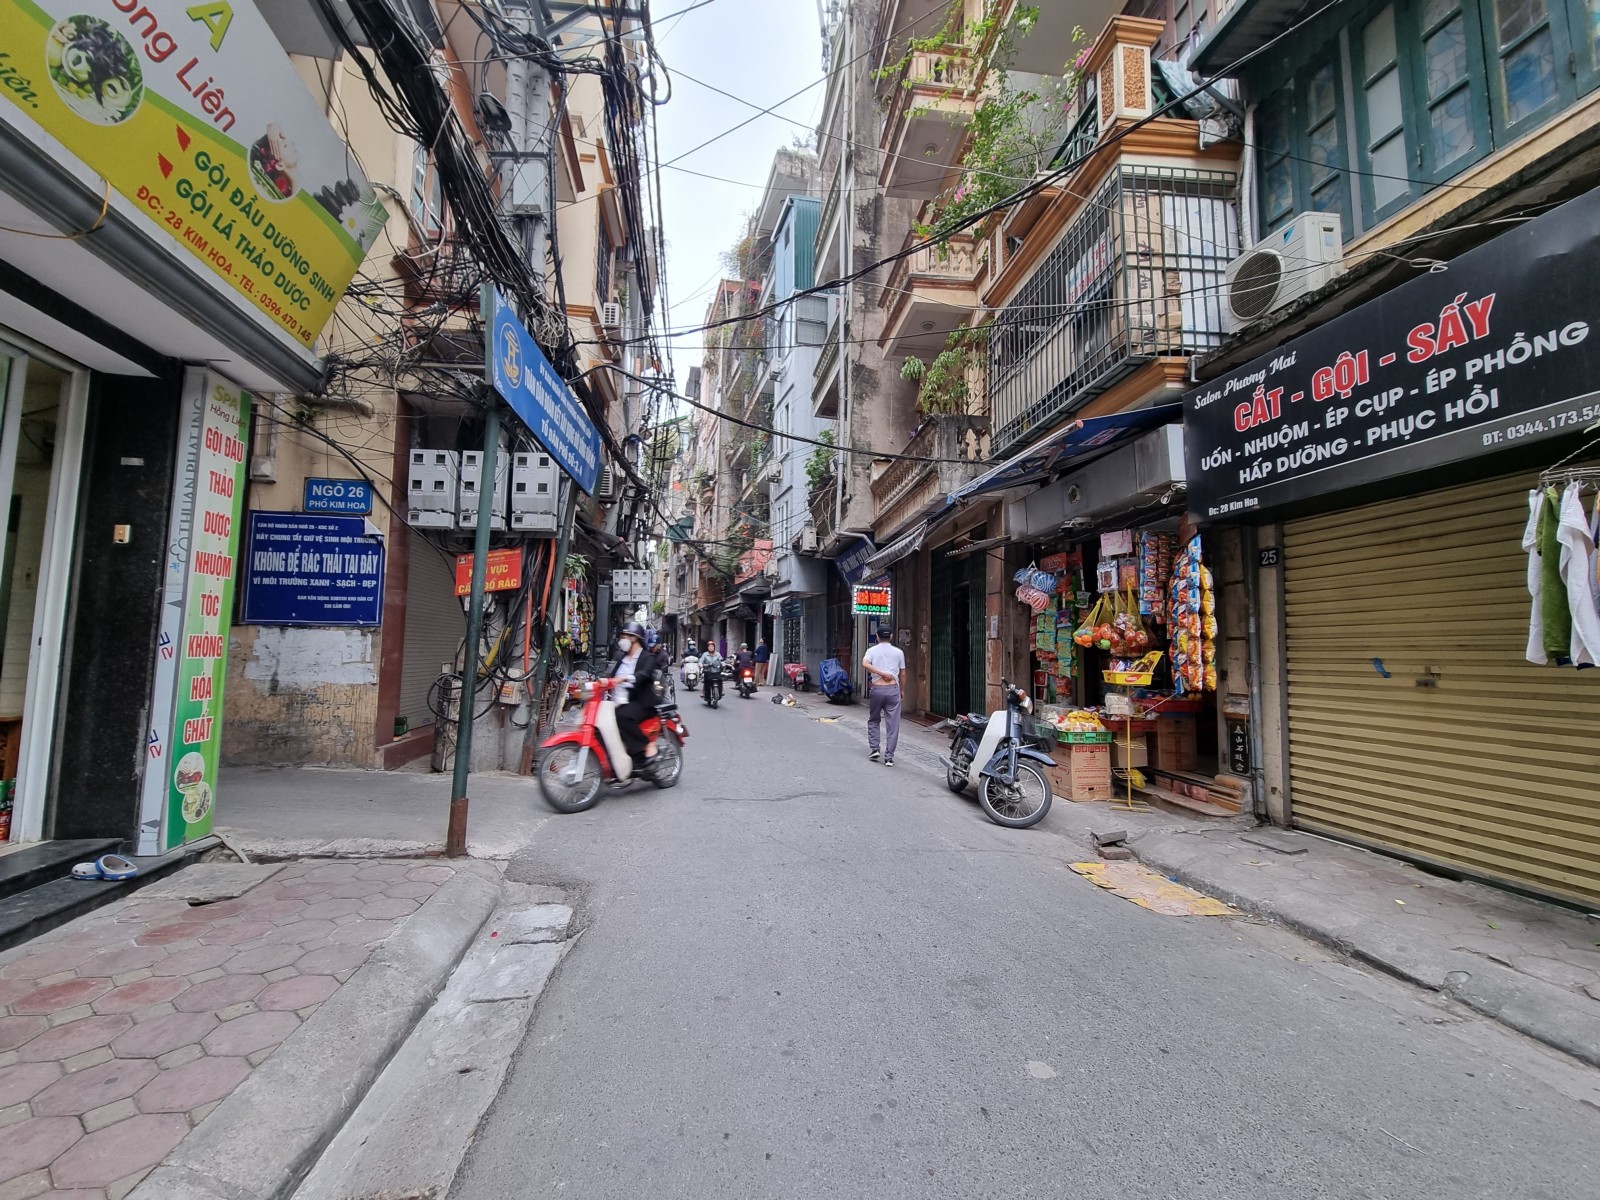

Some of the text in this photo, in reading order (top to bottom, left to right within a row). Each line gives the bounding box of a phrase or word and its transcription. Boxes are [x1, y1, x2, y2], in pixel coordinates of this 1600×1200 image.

[186, 0, 234, 52] A
[176, 57, 236, 132] Liên
[194, 151, 336, 302] GỘI ĐẦU DƯỠNG SINH
[176, 178, 311, 311] GỘI LÁ THẢO DƯỢC
[136, 185, 164, 214] ĐC:
[164, 210, 183, 230] 28
[183, 226, 209, 252] KIM
[207, 247, 233, 275] HOA
[260, 293, 280, 317] 0396
[281, 311, 298, 329] 470
[297, 324, 312, 342] 145
[1233, 291, 1496, 432] CẮT GỘI SẤY
[1194, 350, 1297, 410] Salon Phương Mai
[1201, 321, 1590, 471] UỐN NHUỘM ÉP CỤP ÉP PHỒNG
[210, 403, 247, 429] Hồng Liên
[205, 426, 244, 463] GỘI ĐẦU
[1239, 383, 1499, 484] HẤP DƯỠNG PHỤC HỒI
[1482, 430, 1503, 446] ĐT:
[209, 468, 234, 498] THẢO
[312, 483, 364, 498] NGÕ 26
[309, 498, 366, 510] PHỐ KIM HOA
[1220, 504, 1229, 514] 28
[1229, 500, 1243, 511] Kim
[1244, 496, 1258, 507] Hoa
[203, 511, 231, 541] DƯỢC
[324, 535, 339, 543] SINH
[194, 550, 232, 581] NHUỘM
[254, 544, 378, 578] KHÔNG ĐỂ RÁC THẢI TẠI ĐÂY
[490, 564, 509, 576] VỰC
[1261, 550, 1277, 565] 25
[253, 576, 377, 589] VÌ MÔI TRƯỜNG XANH SẠCH ĐẸP
[458, 581, 471, 594] CẤ
[498, 578, 518, 589] RÁC
[200, 590, 220, 617] TÓC
[187, 631, 224, 659] KHÔNG
[190, 672, 213, 700] HÓA
[183, 710, 214, 744] CHẤT
